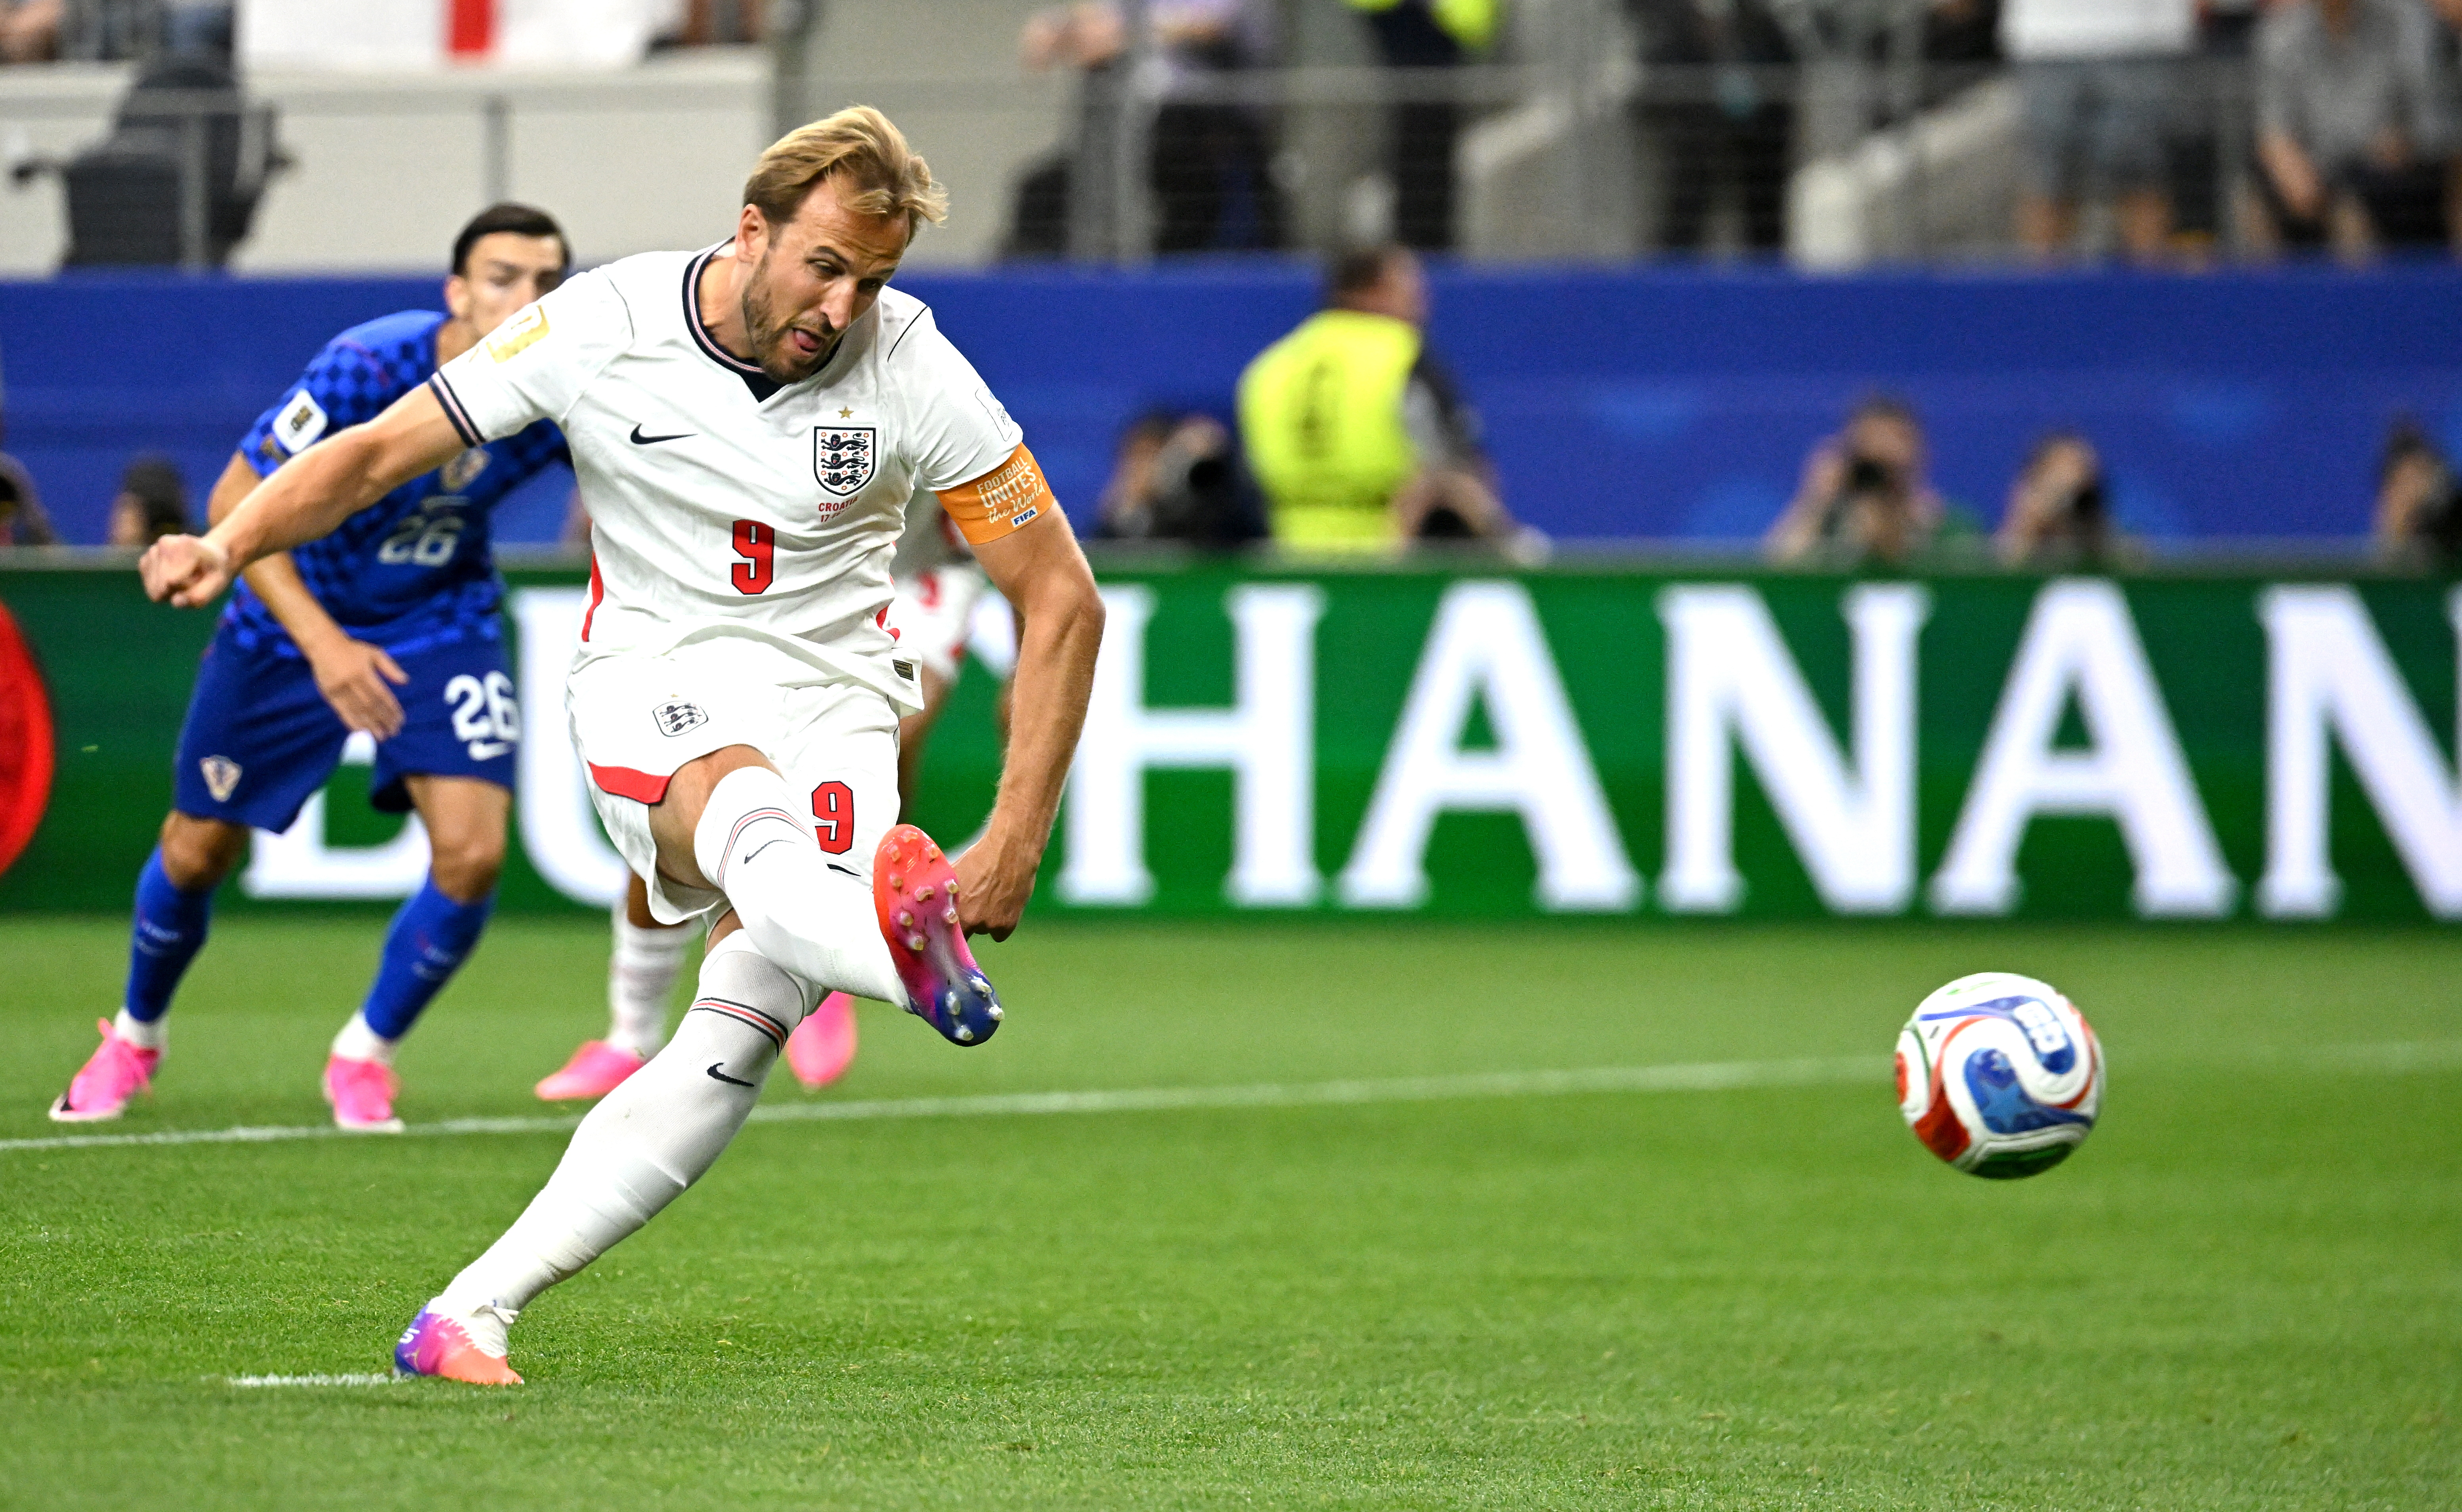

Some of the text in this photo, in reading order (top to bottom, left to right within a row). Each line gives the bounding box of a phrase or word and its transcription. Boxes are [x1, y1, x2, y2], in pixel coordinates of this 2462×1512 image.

[977, 456, 1027, 494] FOOTBALL
[981, 466, 1036, 508] UNITES
[818, 496, 858, 512] CROATIA
[986, 478, 1045, 523] the World
[1013, 510, 1036, 525] FIFA
[378, 515, 464, 567] 26
[731, 519, 774, 595] 9
[444, 670, 520, 741] 26
[240, 578, 2462, 916] UHANAN
[811, 781, 854, 855] 9
